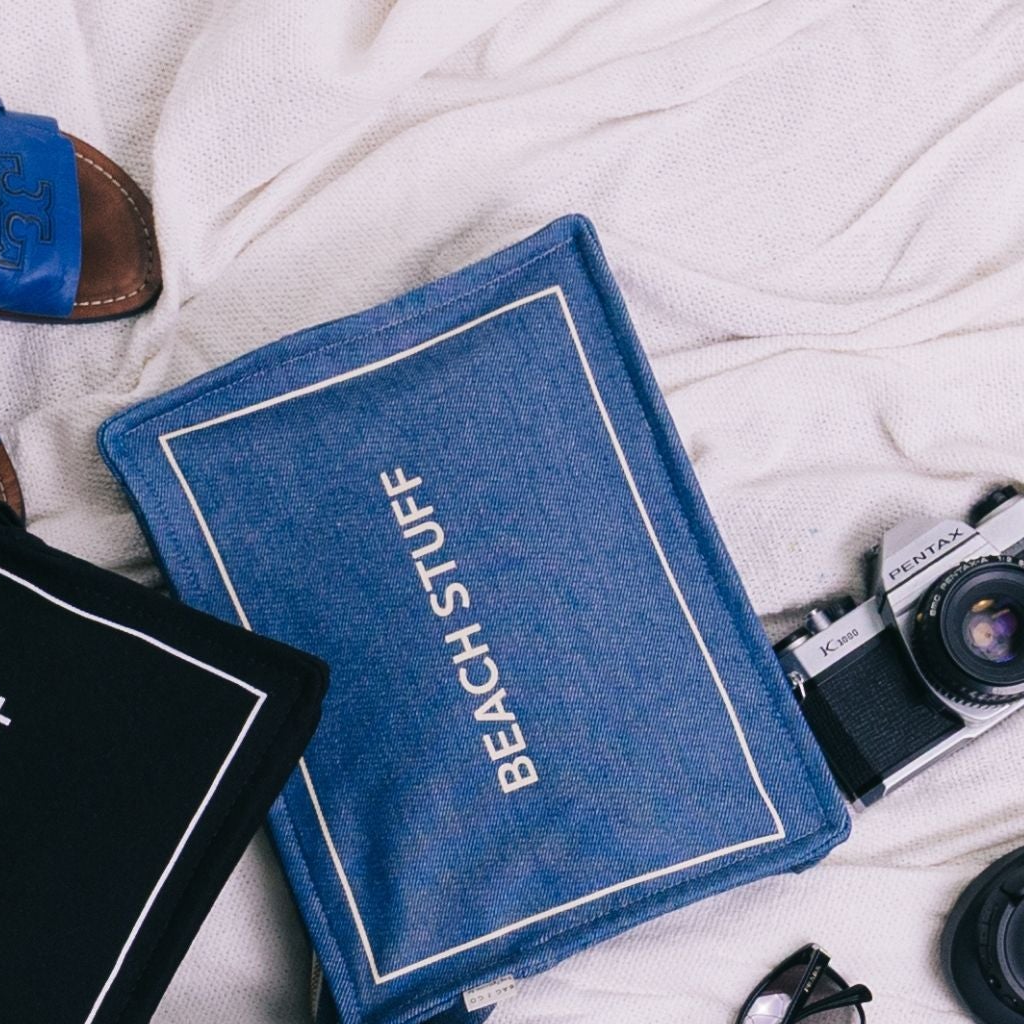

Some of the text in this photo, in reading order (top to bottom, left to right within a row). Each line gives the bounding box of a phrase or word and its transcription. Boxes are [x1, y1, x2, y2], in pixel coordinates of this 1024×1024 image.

[380, 467, 539, 794] BEACH STUFF
[888, 528, 964, 581] PENTAX
